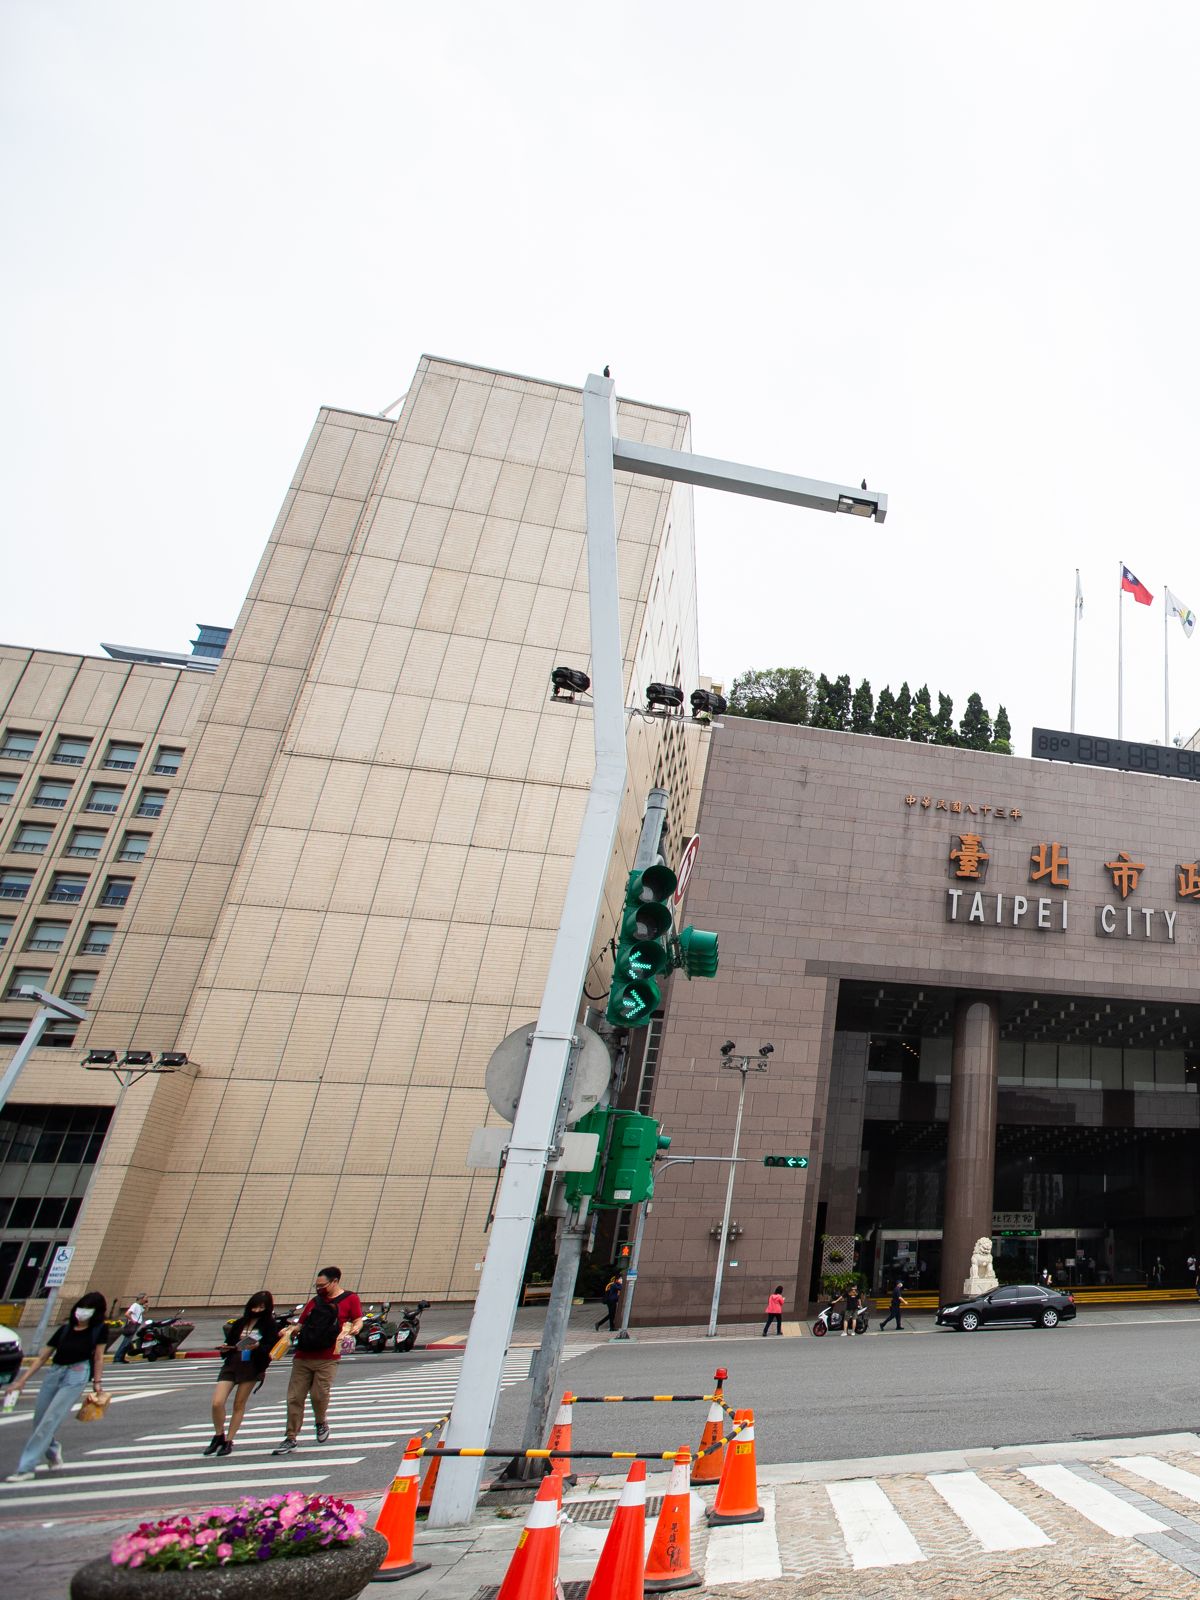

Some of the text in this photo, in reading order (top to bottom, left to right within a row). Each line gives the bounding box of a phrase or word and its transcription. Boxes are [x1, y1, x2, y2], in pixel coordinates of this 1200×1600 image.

[905, 795, 1022, 821] 中華民國八十三年
[948, 889, 1068, 930] TAIPEI
[1101, 904, 1177, 940] CITY
